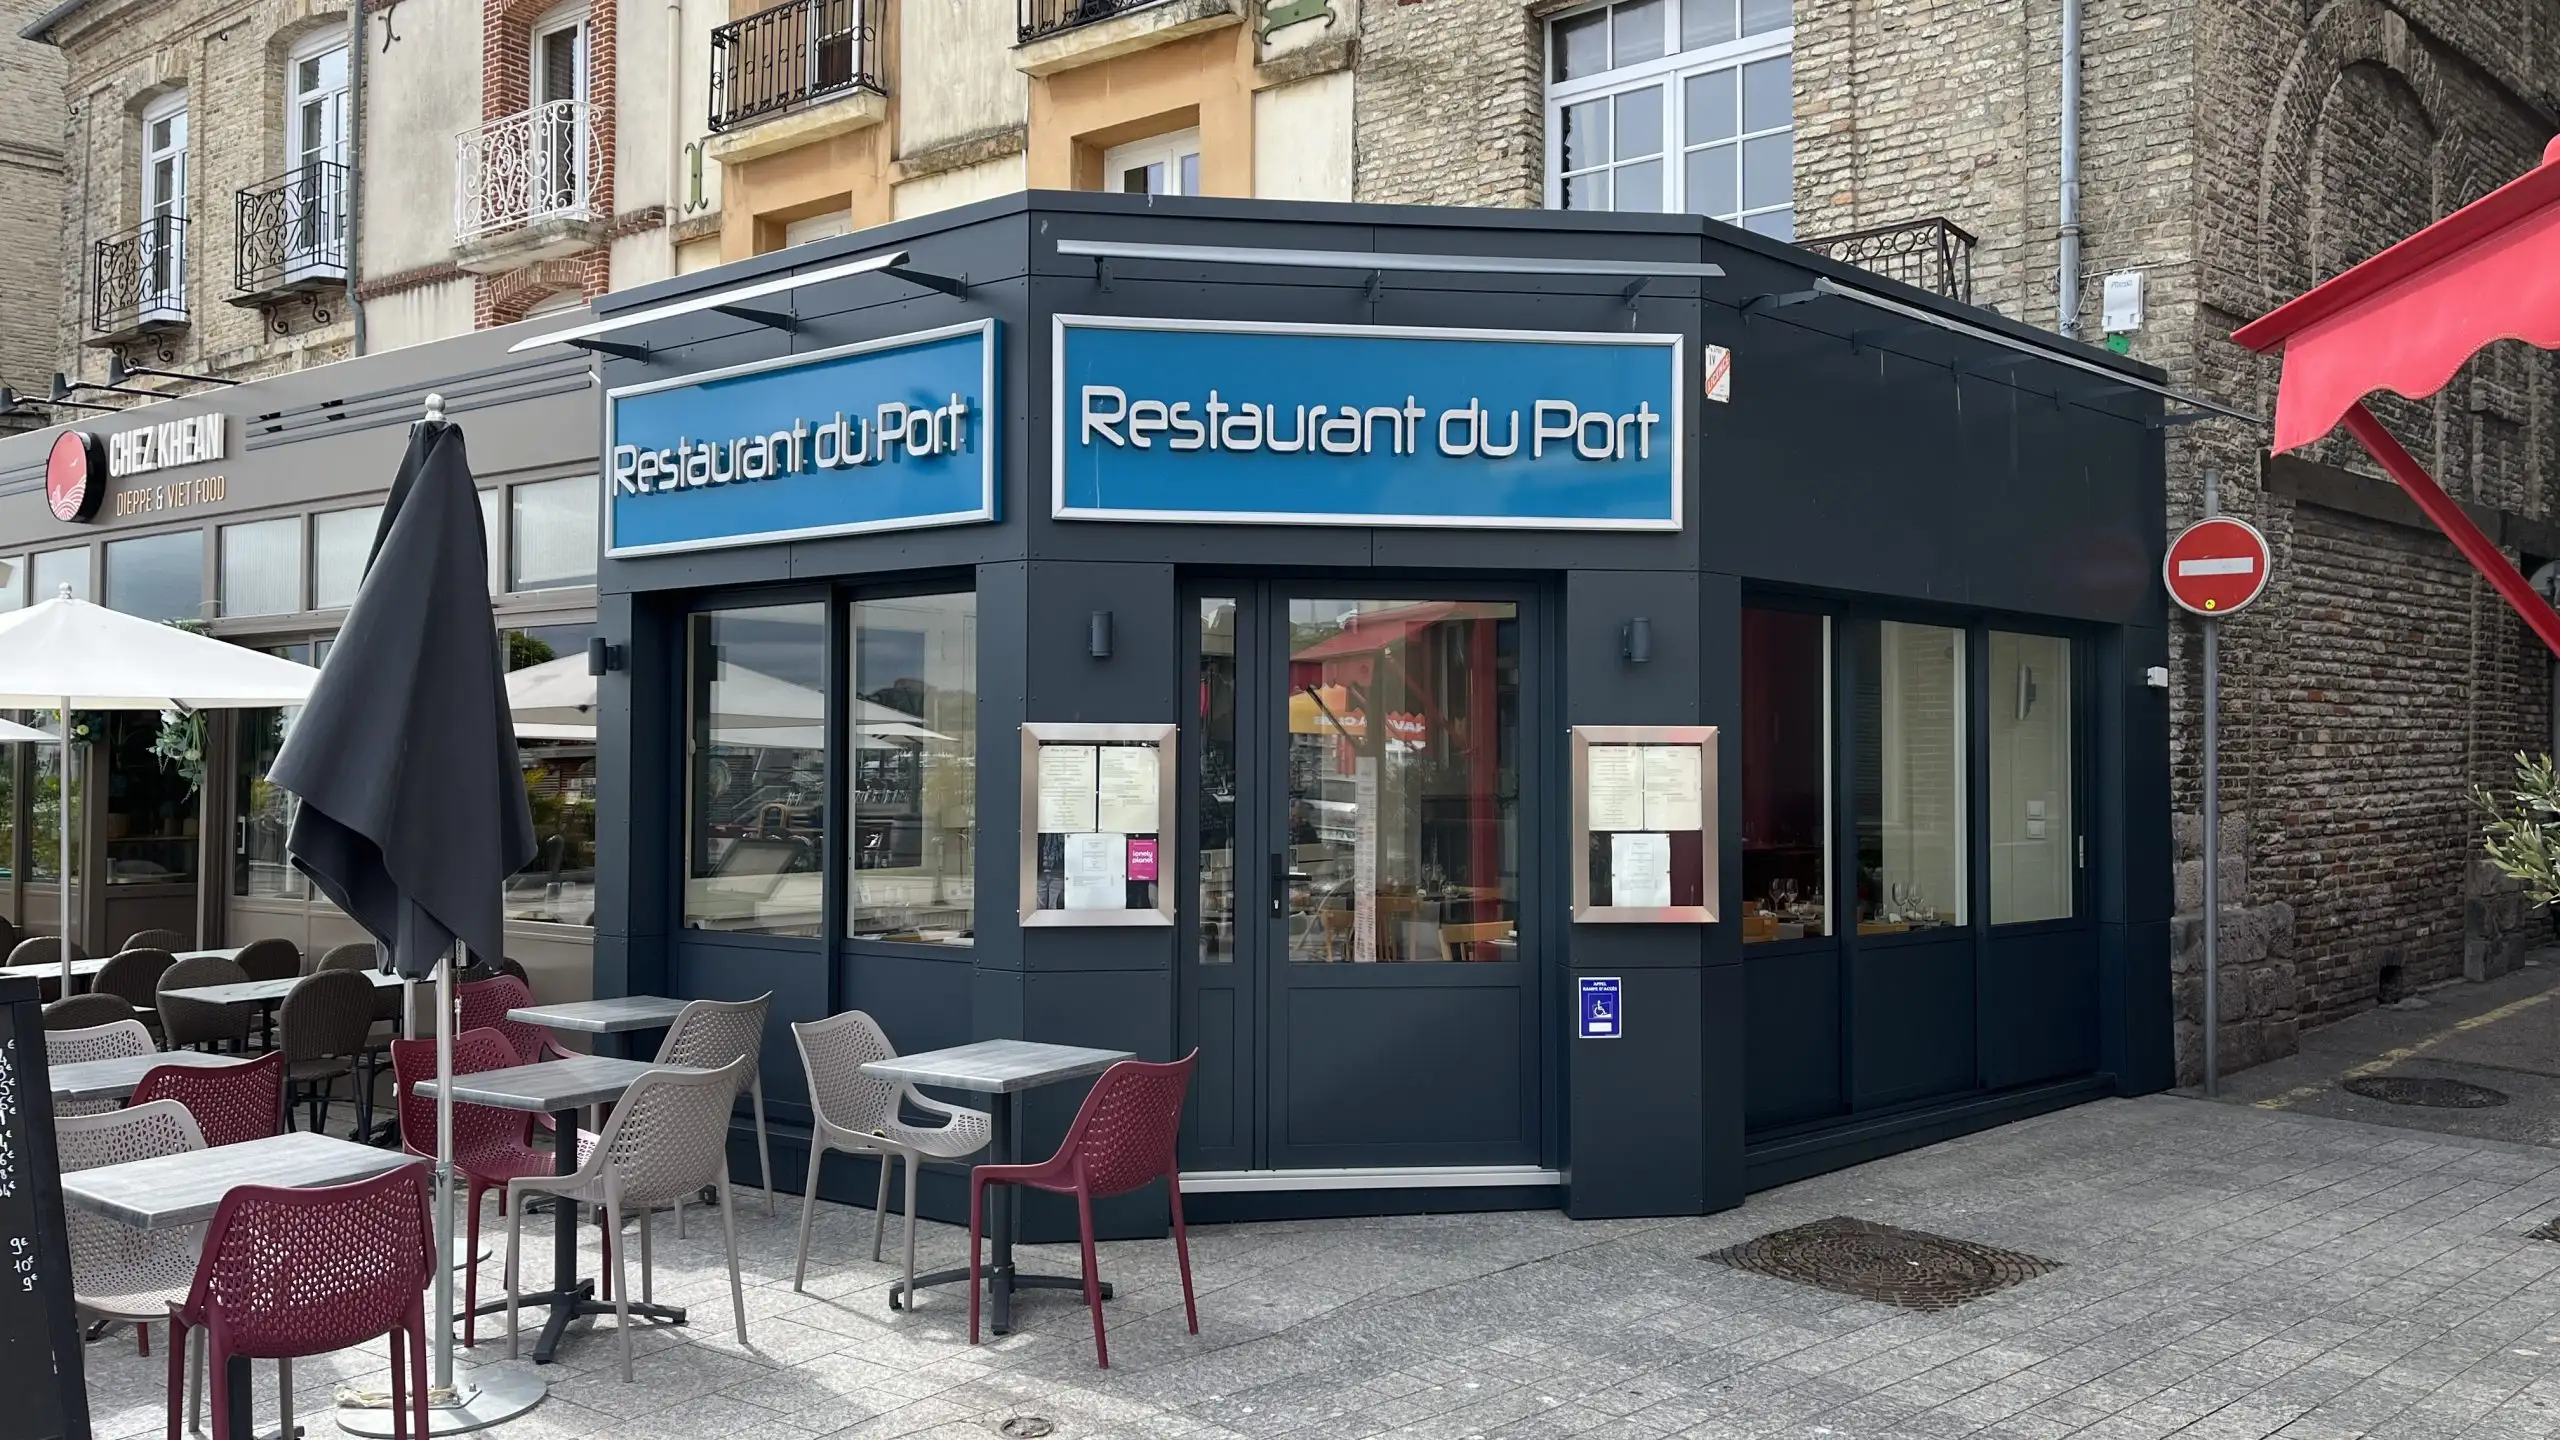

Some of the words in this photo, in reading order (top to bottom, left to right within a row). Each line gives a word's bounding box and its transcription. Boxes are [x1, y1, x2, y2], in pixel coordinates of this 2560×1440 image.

[109, 425, 158, 478] CHEZ
[157, 412, 225, 468] KHEAN
[613, 416, 807, 497] Restaurant
[814, 410, 870, 469] du
[877, 392, 969, 462] Port
[1081, 385, 1426, 456] Restaurant
[1439, 396, 1520, 457] du
[1534, 399, 1659, 461] Port
[116, 487, 153, 517] DIEPPE
[156, 485, 164, 510] &
[167, 480, 192, 508] VIET
[195, 475, 225, 505] FOOD
[1133, 850, 1153, 858] lonely
